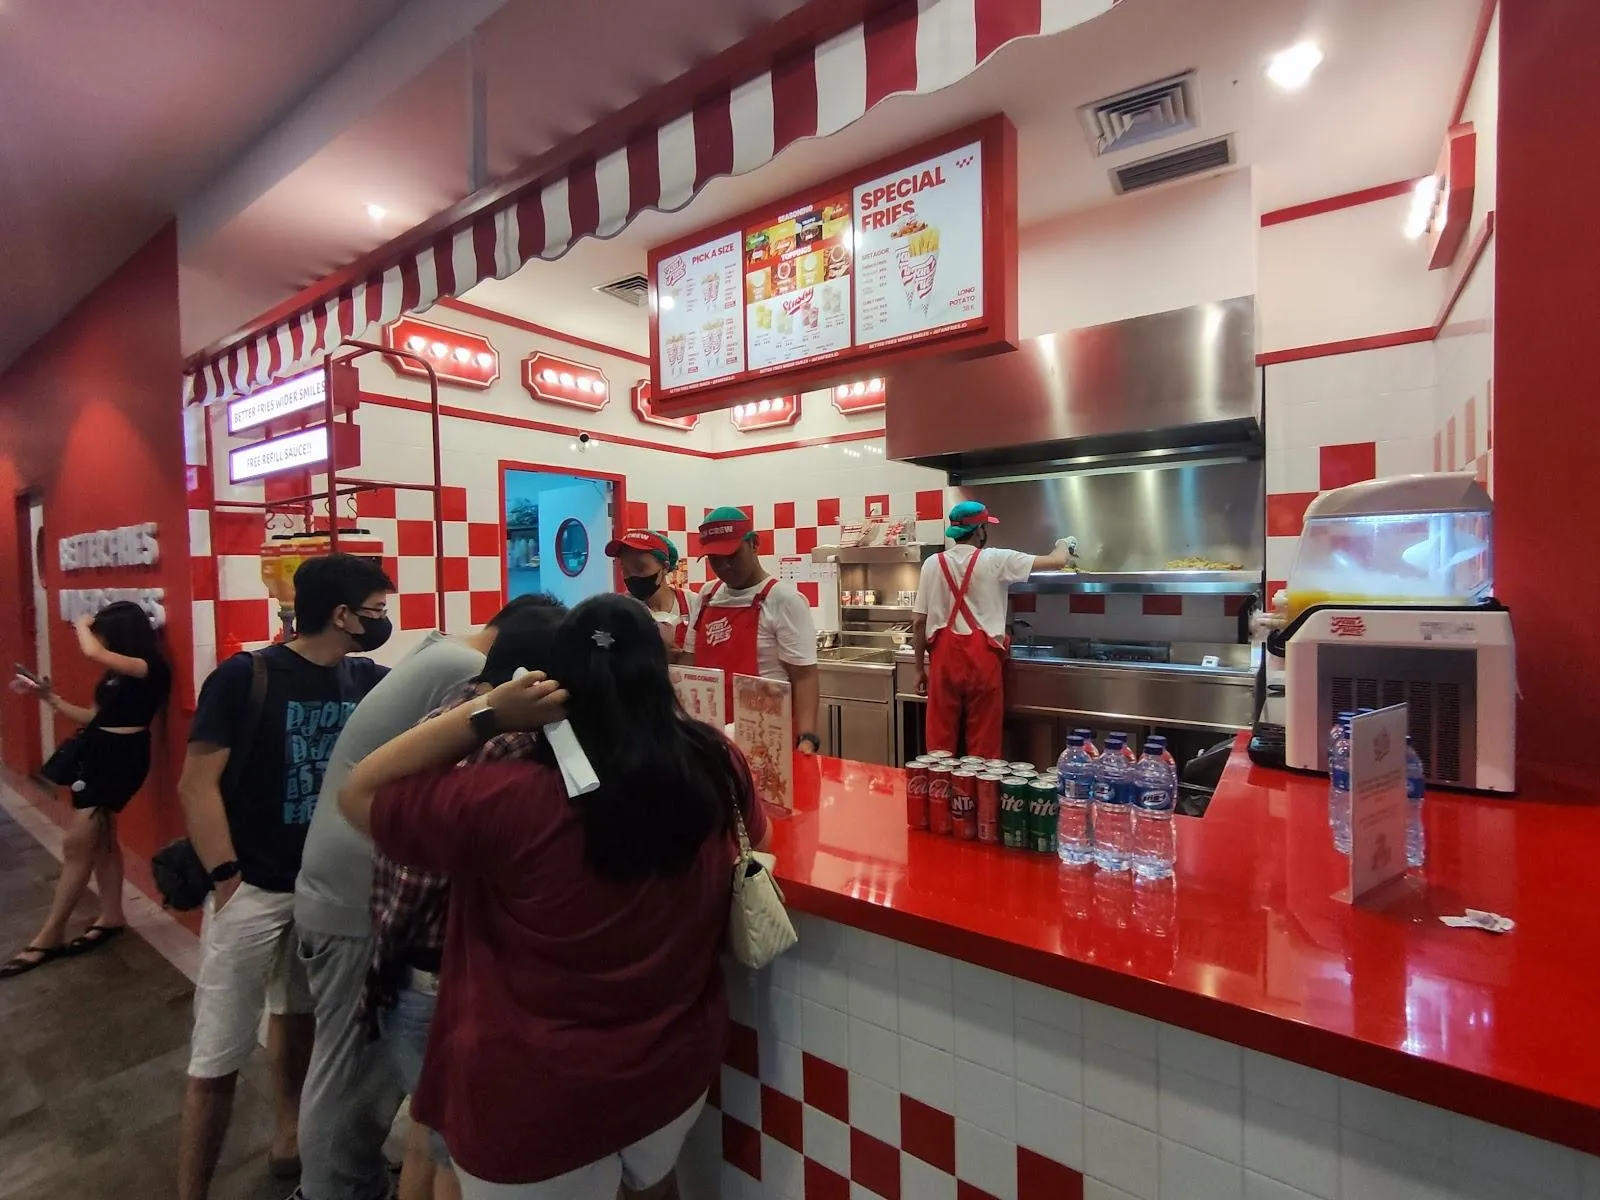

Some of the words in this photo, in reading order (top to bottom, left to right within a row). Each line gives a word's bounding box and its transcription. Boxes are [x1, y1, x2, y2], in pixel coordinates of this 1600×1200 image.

[861, 167, 946, 211] SPECIAL
[777, 205, 813, 223] SEASONING
[861, 200, 915, 234] FRIES
[692, 252, 710, 264] PICK
[711, 250, 717, 259] A
[718, 243, 735, 255] SIZE
[957, 287, 975, 297] LONG
[949, 295, 975, 307] POTATO
[234, 407, 256, 423] BETTER
[257, 399, 274, 414] FRIES
[275, 391, 297, 409] WIDER
[299, 381, 326, 401] SMILES
[247, 455, 261, 467] FREE
[262, 450, 283, 465] REFILL
[626, 532, 650, 541] CREW
[708, 525, 733, 535] CREW
